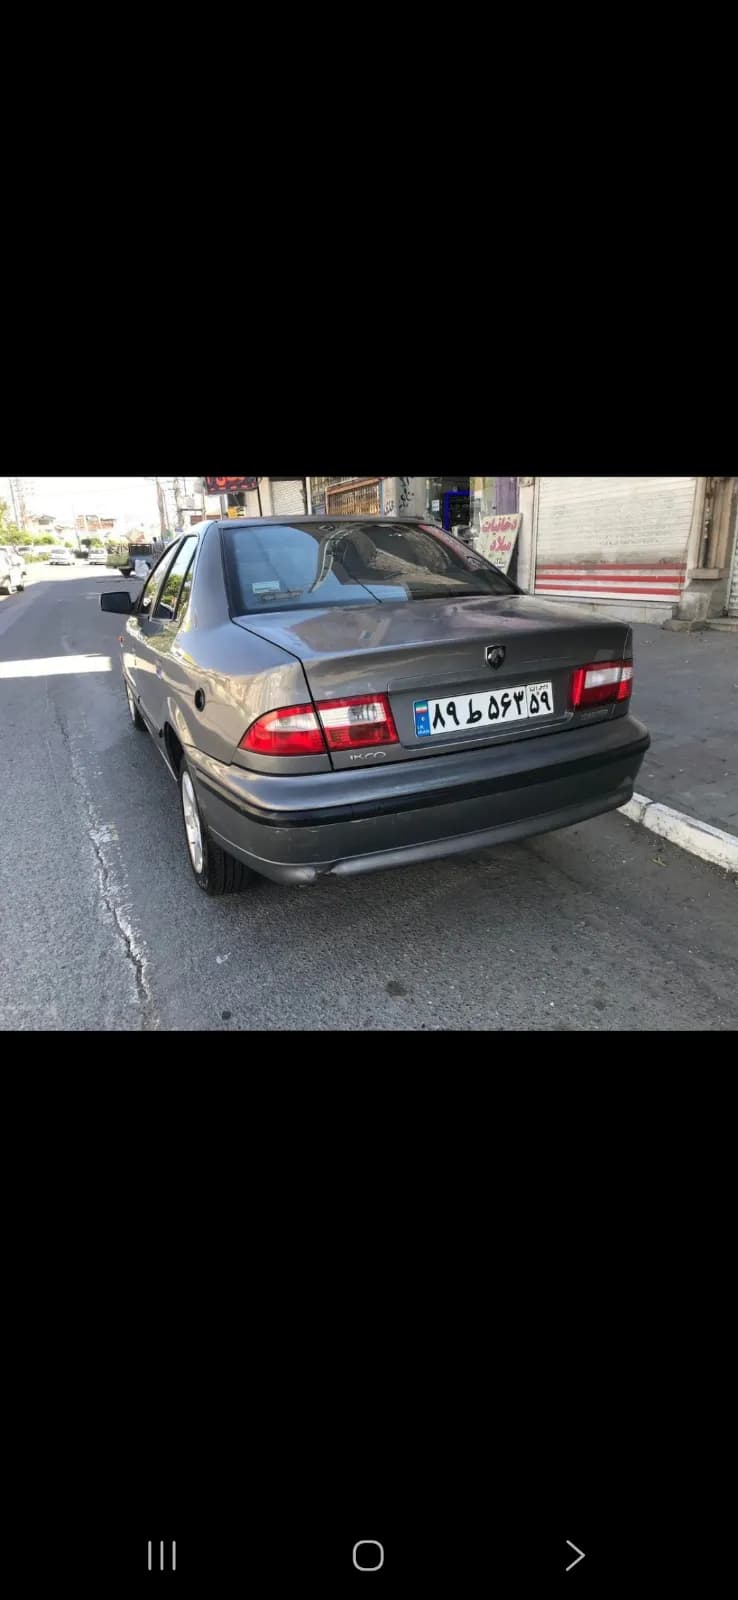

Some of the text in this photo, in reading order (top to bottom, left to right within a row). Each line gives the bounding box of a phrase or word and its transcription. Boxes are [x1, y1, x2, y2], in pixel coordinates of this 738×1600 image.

[482, 516, 517, 535] دخانیات
[489, 535, 512, 554] میلاد
[432, 690, 551, 729] ۸۹ ط ۵۶۳ ۵۹
[349, 751, 386, 760] IKCO
